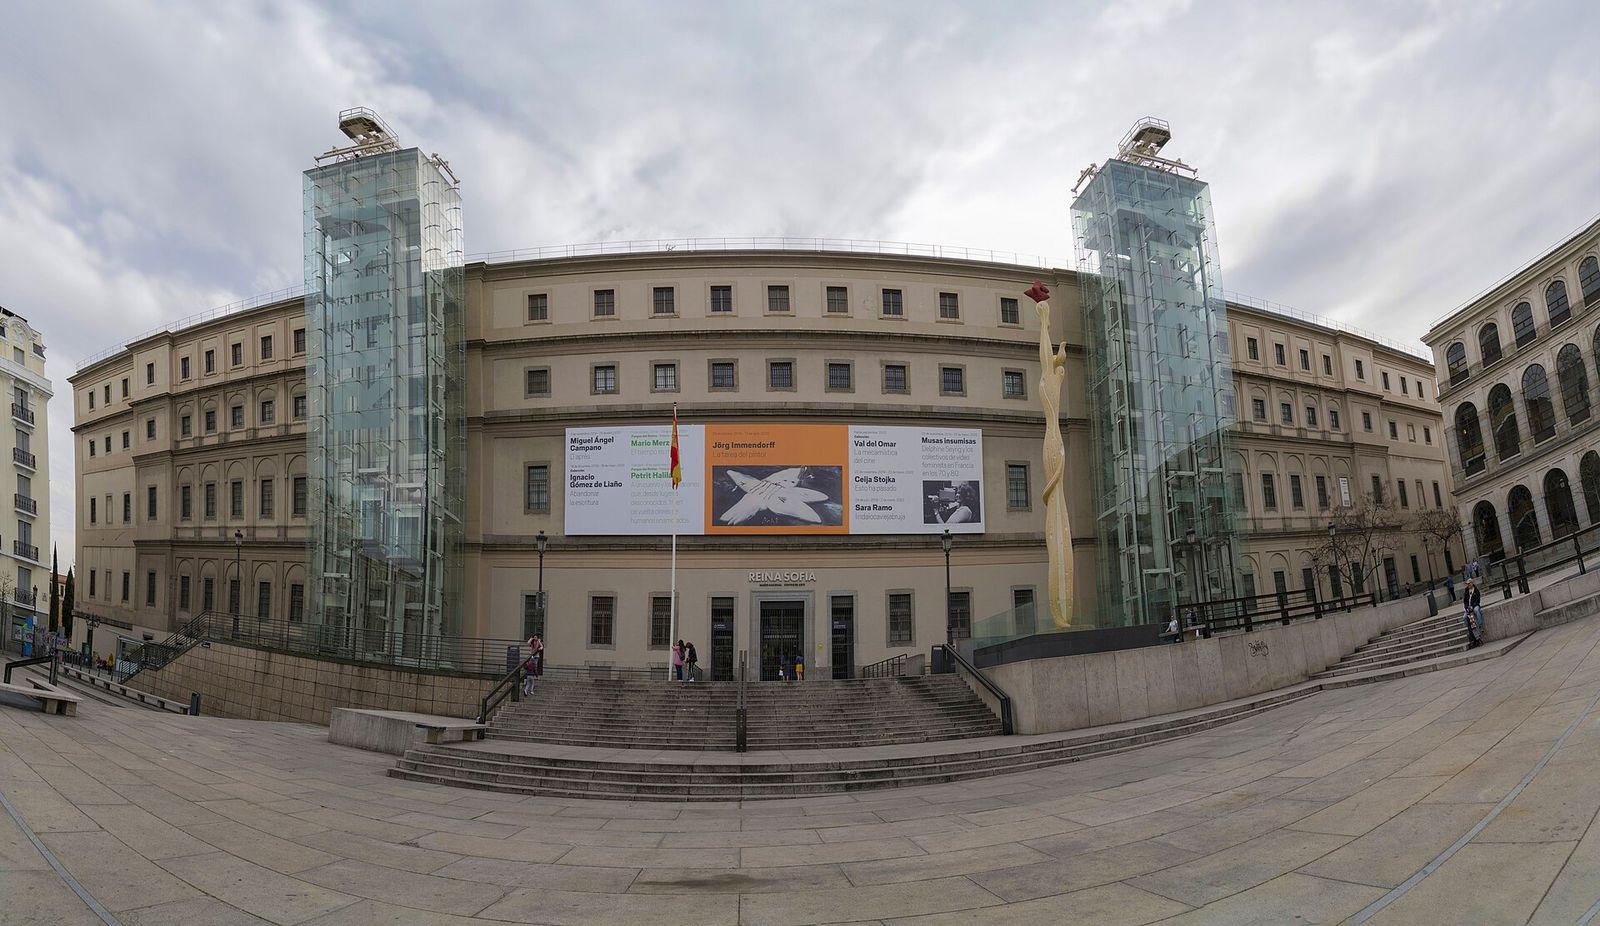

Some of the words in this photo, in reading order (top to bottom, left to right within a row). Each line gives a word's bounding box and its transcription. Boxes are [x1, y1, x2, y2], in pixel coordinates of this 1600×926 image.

[570, 437, 593, 445] Miguel
[594, 435, 614, 445] Ángel
[944, 437, 977, 445] insumisas
[712, 442, 730, 450] Jörg
[570, 473, 595, 482] Ignacio
[854, 476, 873, 484] Ceija
[873, 476, 896, 484] Stojka
[748, 572, 781, 582] REINA
[783, 571, 816, 582] SOFIA
